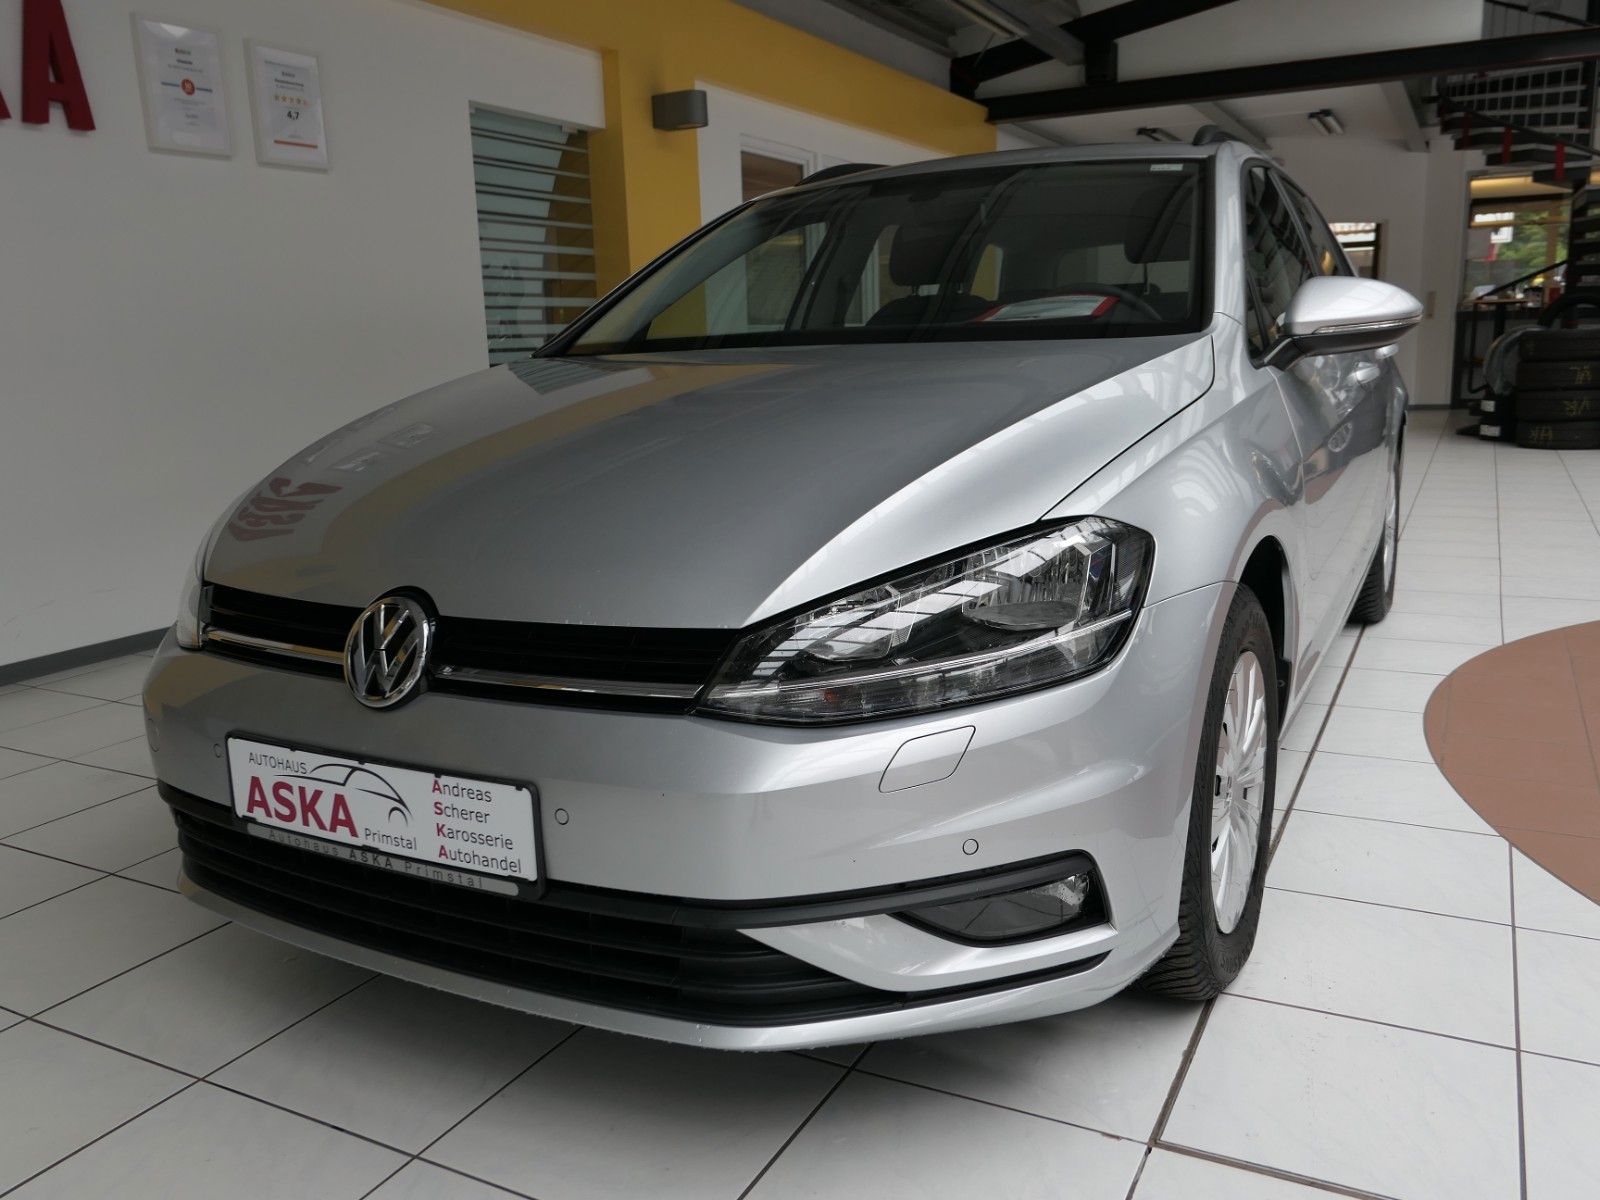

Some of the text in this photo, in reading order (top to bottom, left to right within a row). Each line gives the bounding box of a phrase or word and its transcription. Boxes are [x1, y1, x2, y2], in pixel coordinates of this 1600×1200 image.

[0, 0, 96, 131] A
[248, 752, 308, 774] AUTOHAUS
[432, 779, 493, 803] Andreas
[246, 775, 359, 838] ASKA
[433, 801, 490, 824] Scherer
[364, 828, 418, 851] Primstal
[436, 822, 514, 850] Karosserie
[269, 830, 483, 888] Autohaus ASKA Primstal
[438, 845, 522, 874] Autohandel
